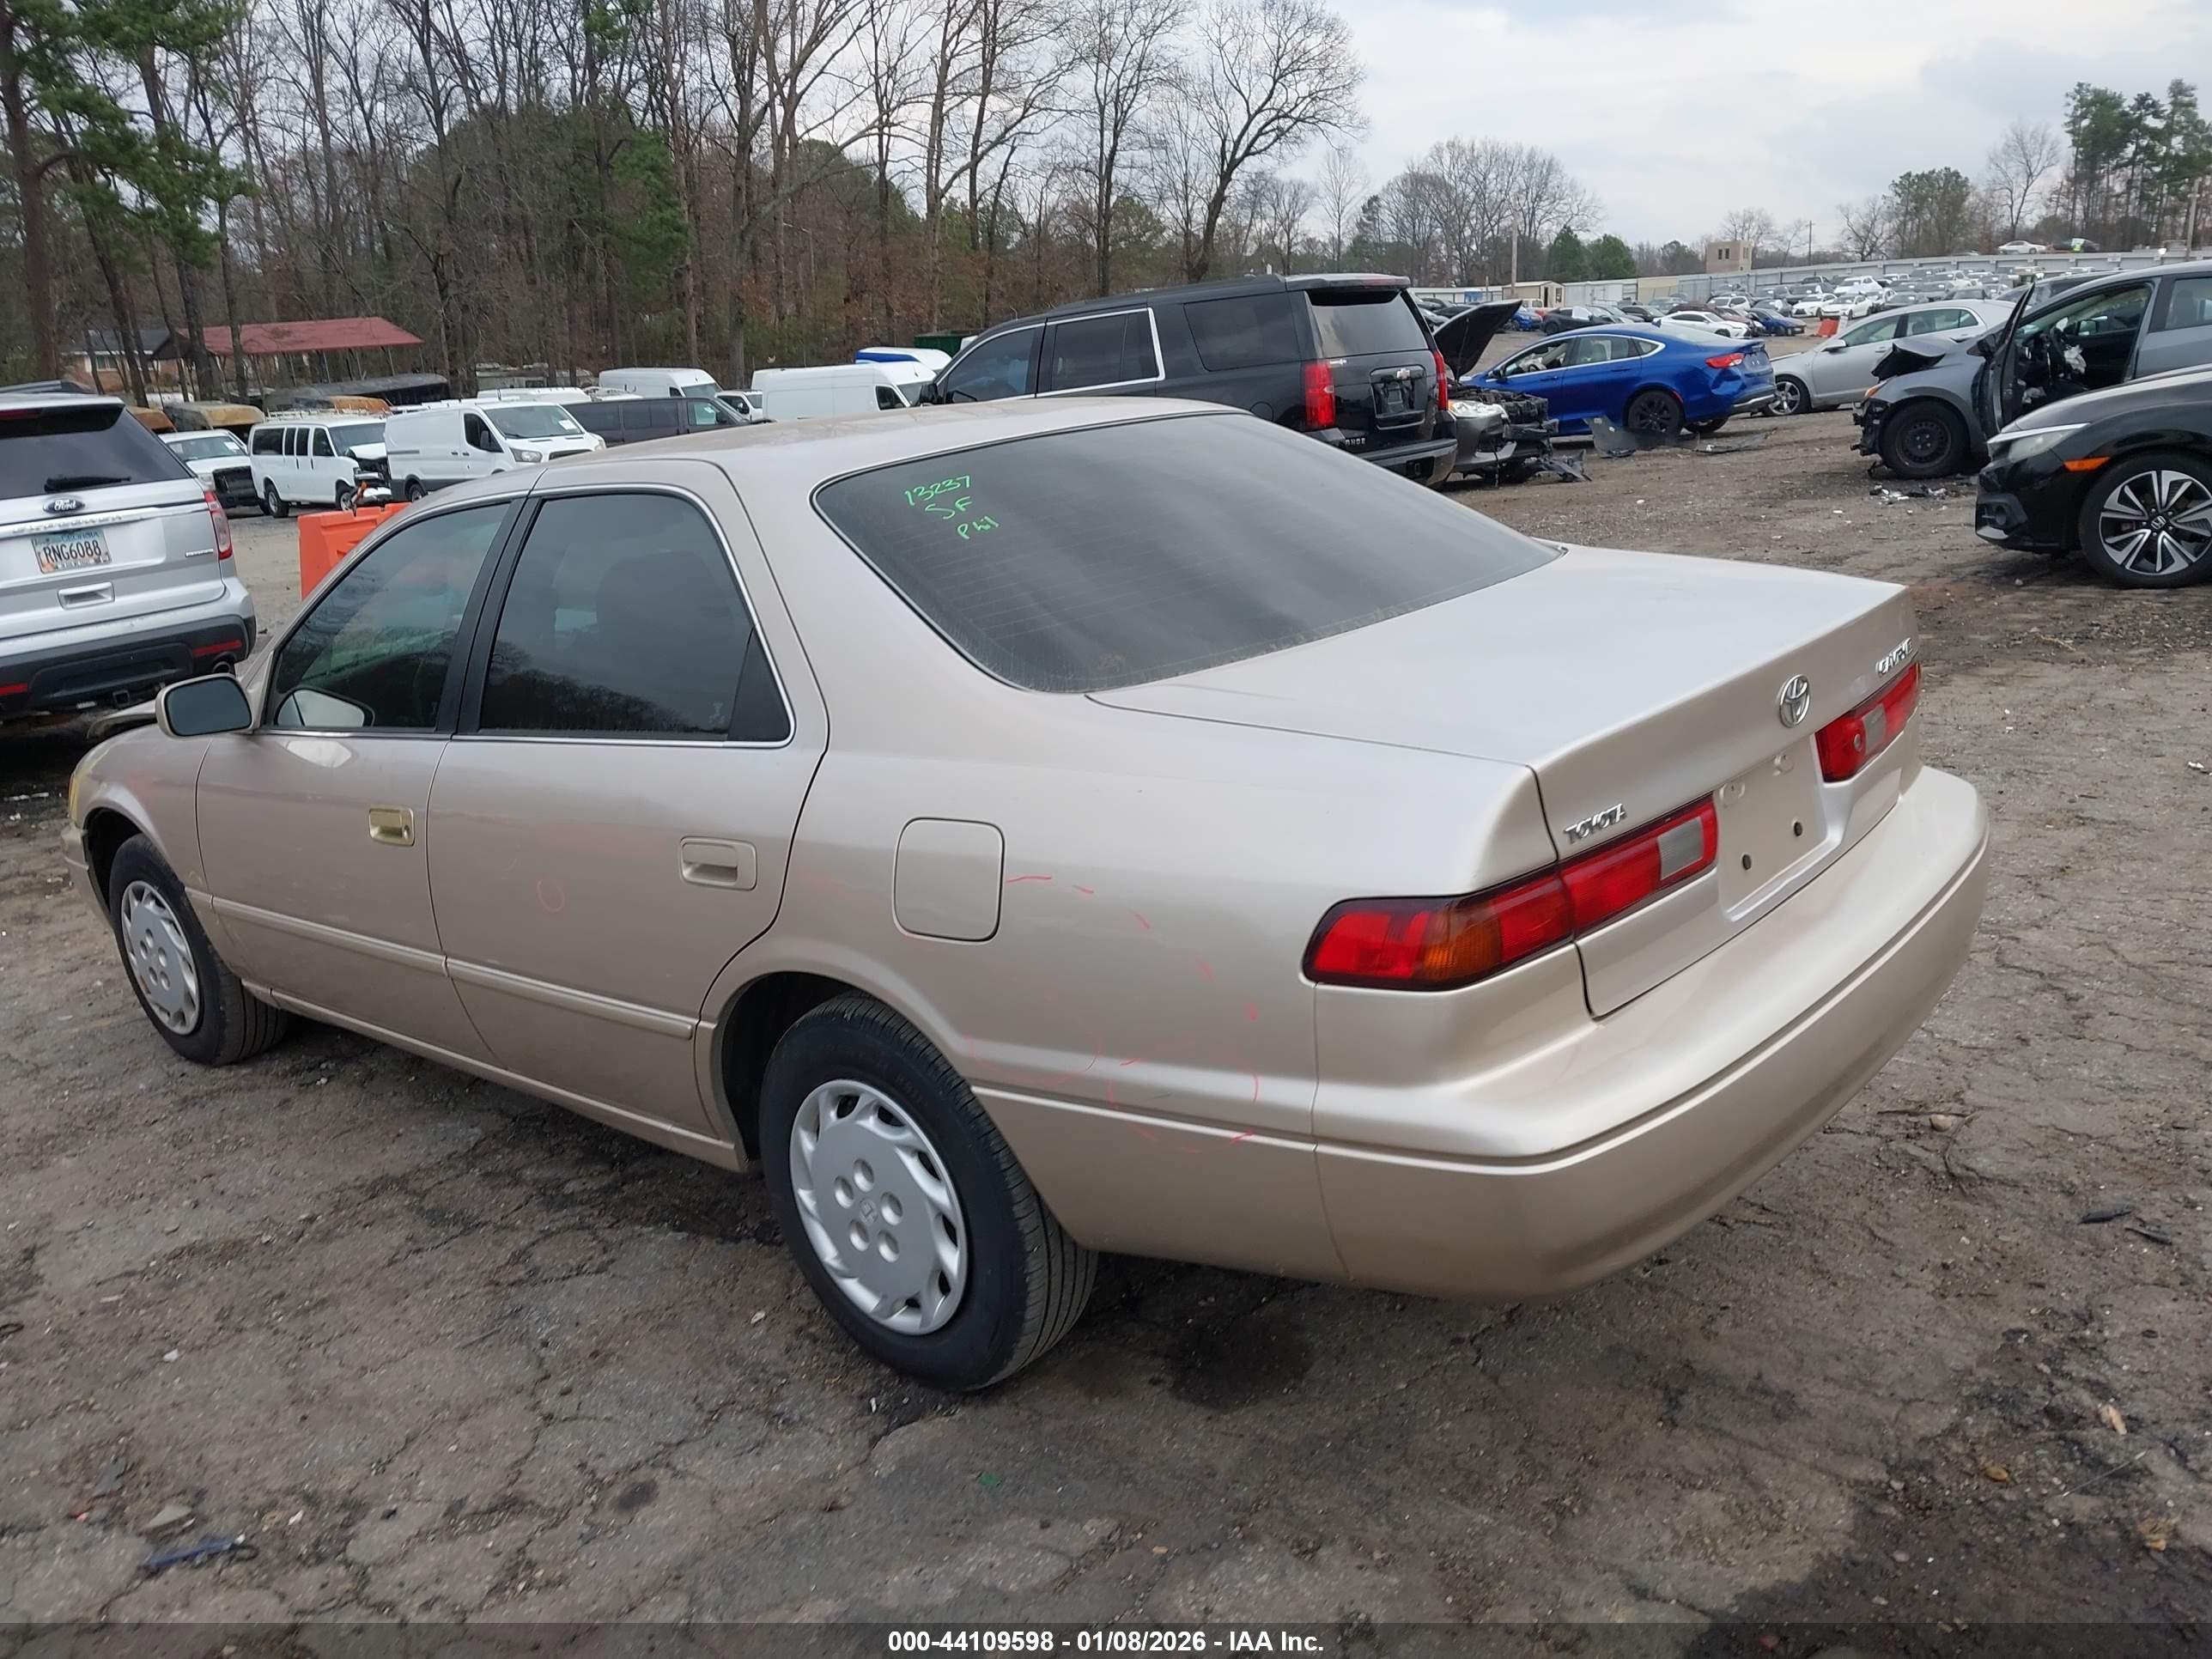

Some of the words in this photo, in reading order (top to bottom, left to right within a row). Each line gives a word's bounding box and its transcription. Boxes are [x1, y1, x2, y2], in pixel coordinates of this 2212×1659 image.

[904, 475, 970, 505] 13237
[54, 499, 77, 511] Ford
[44, 540, 101, 563] RNG6088
[1564, 803, 1626, 844] TOYOTA
